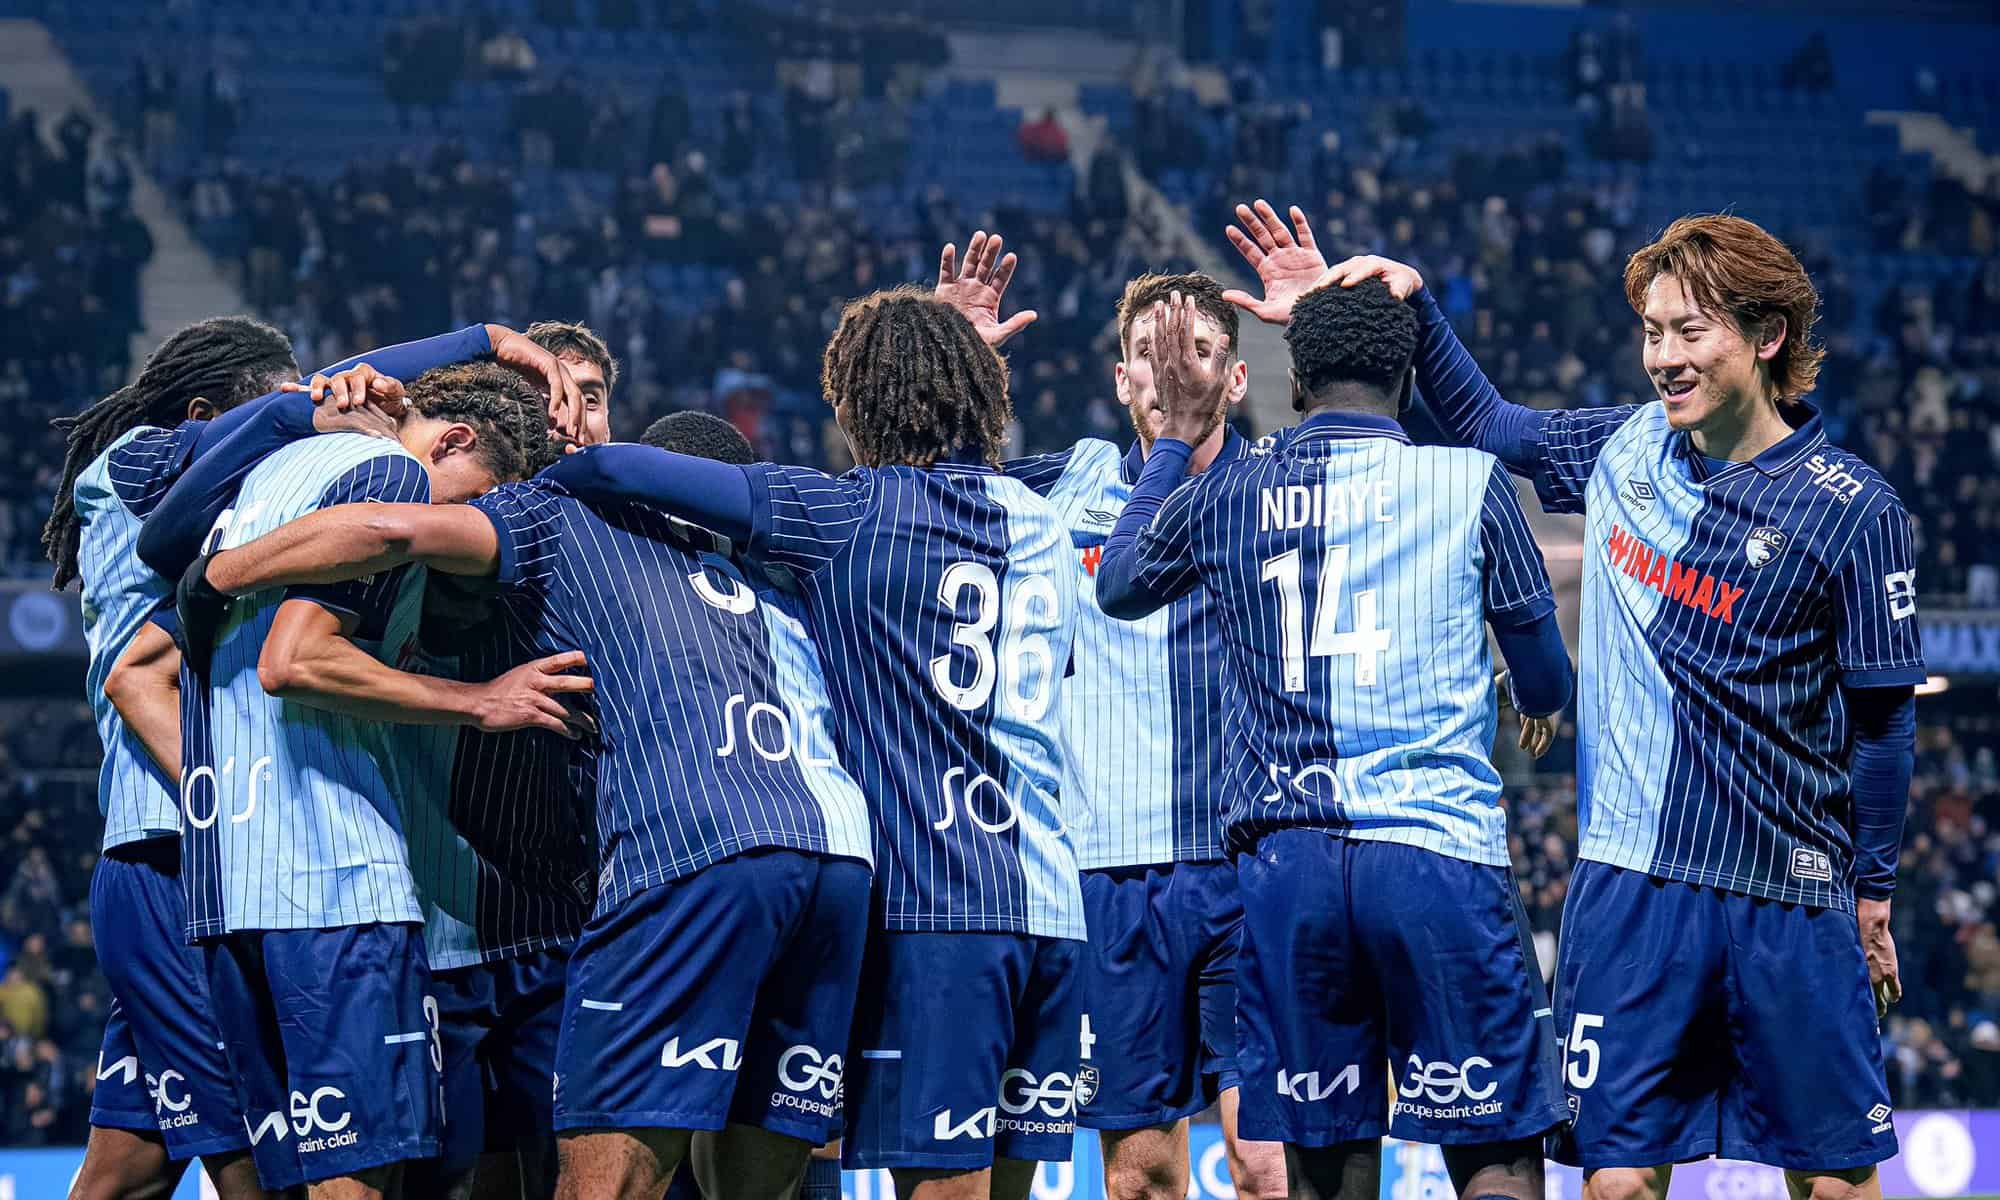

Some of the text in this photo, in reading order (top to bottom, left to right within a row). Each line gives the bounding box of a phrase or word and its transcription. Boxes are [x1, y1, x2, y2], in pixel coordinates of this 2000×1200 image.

[1261, 480, 1394, 532] NDIAYE
[1620, 491, 1647, 511] umbro
[1753, 529, 1782, 545] HAC
[1608, 524, 1745, 624] WINAMAX
[929, 561, 1060, 721] 36
[1262, 544, 1392, 692] 14
[181, 755, 273, 835] O'S
[1563, 1013, 1604, 1089] 5
[771, 1092, 823, 1114] groupe
[1400, 1054, 1498, 1104] GSC
[994, 1117, 1045, 1135] groupe
[1394, 1102, 1433, 1119] groupe
